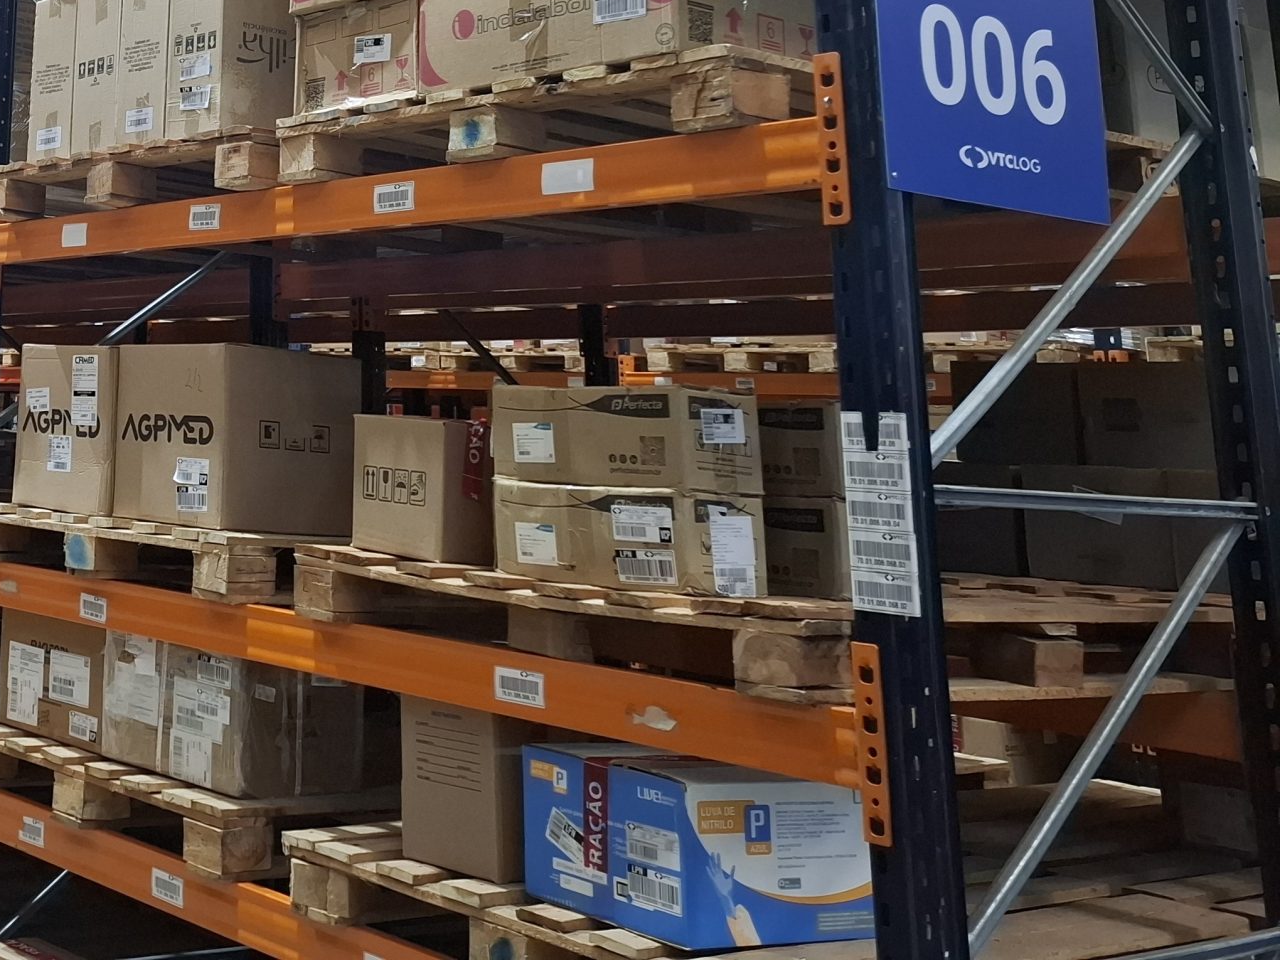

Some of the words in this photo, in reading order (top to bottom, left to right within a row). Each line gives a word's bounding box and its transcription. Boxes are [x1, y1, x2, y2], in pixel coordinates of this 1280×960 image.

[920, 3, 1067, 126] 006
[987, 150, 1042, 174] VTCLOG
[622, 397, 663, 410] Perfecta
[122, 412, 215, 446] AGPMED
[700, 806, 723, 817] LUVA
[724, 806, 736, 816] DE
[700, 819, 734, 830] NITRILO
[750, 809, 765, 838] P
[586, 781, 603, 872] FRAÇÃO
